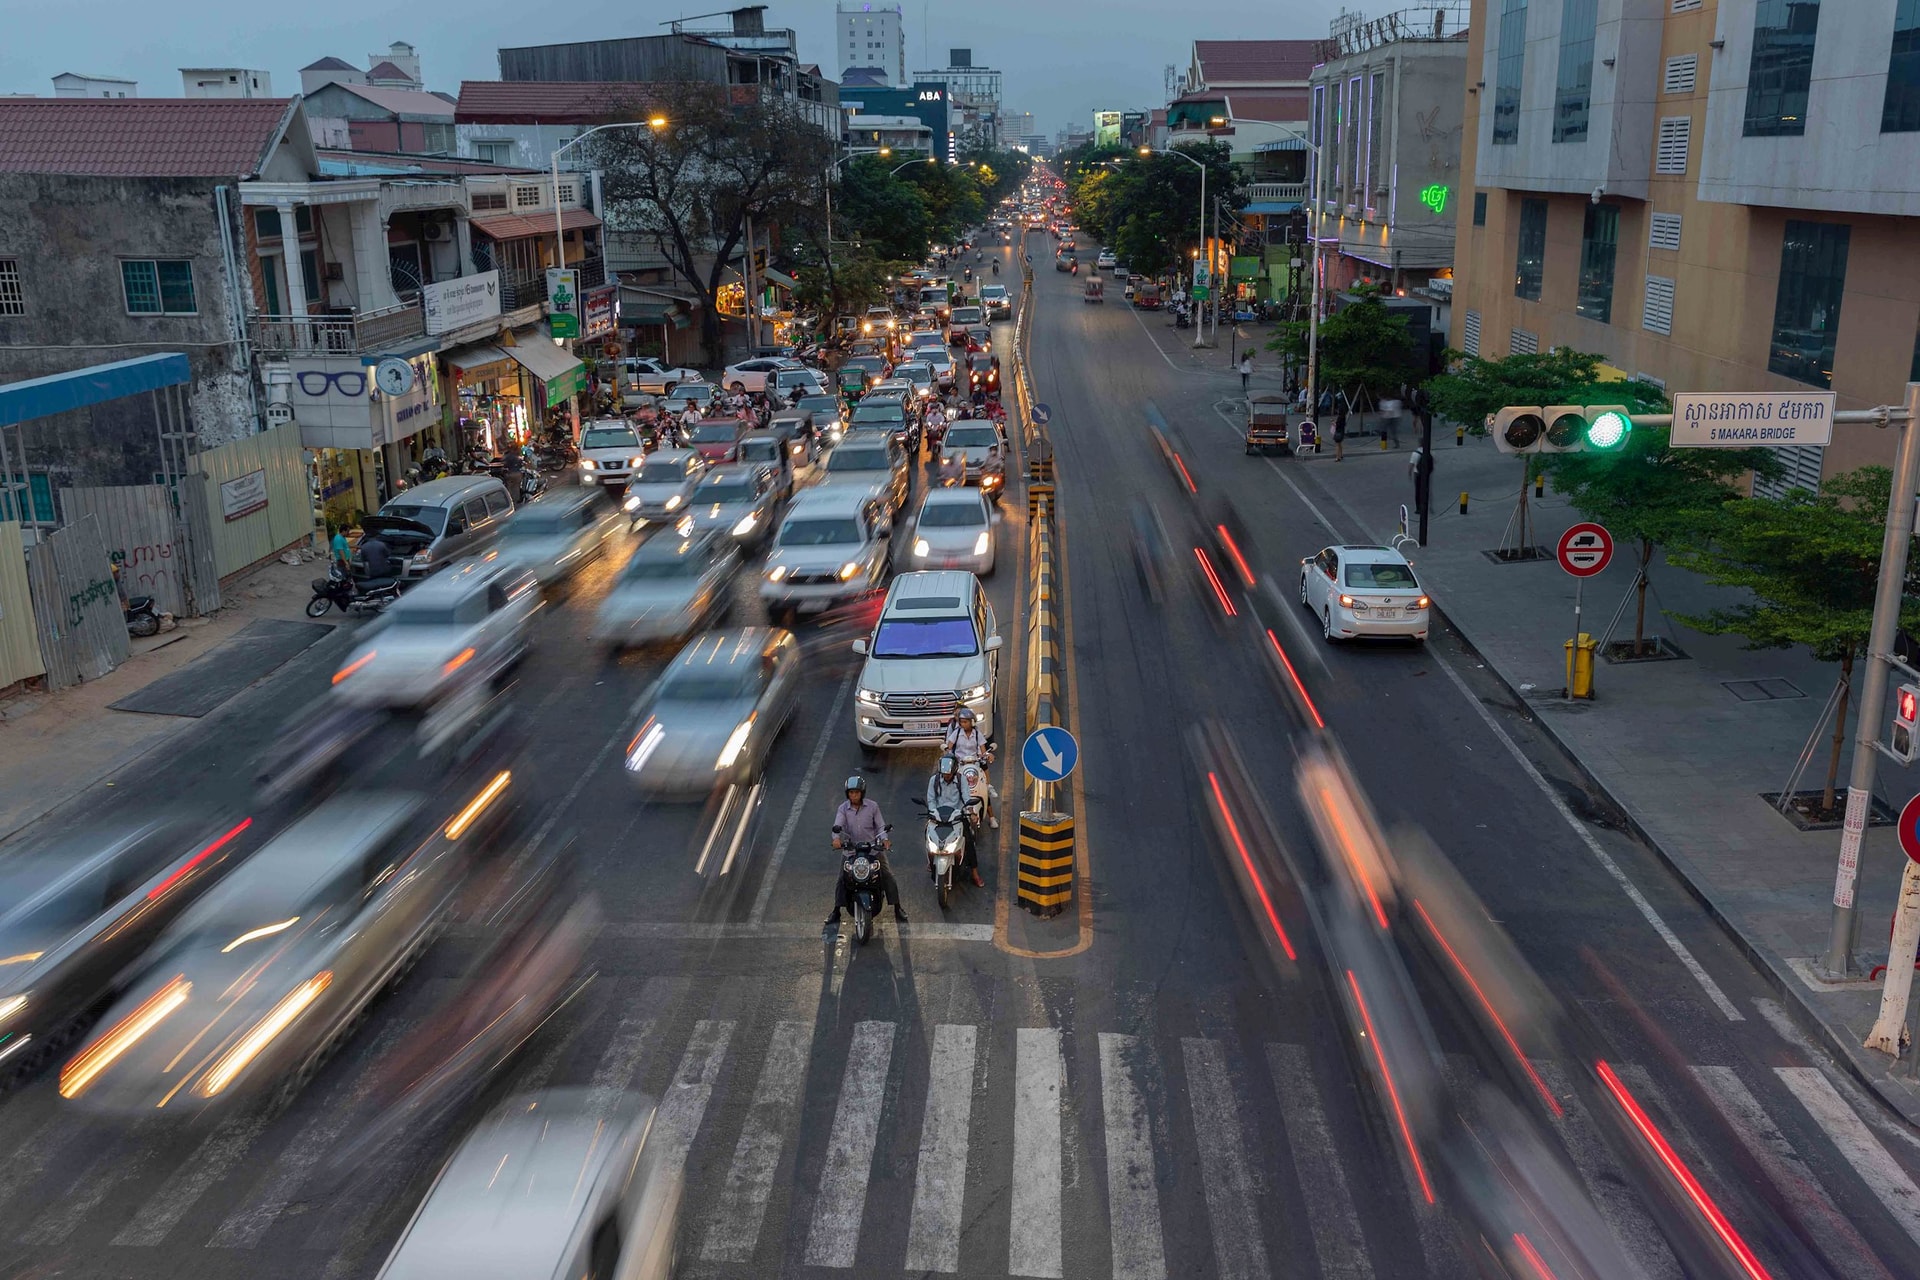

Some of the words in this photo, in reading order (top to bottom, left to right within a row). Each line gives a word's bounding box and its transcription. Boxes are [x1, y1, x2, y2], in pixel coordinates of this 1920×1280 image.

[919, 91, 940, 100] ABA
[1685, 402, 1773, 429] ស្ពានអាកាស
[1778, 400, 1825, 421] ៥មករា
[1710, 428, 1717, 440] 5
[1718, 428, 1758, 440] MAKARA
[1760, 427, 1796, 439] BRIDGE
